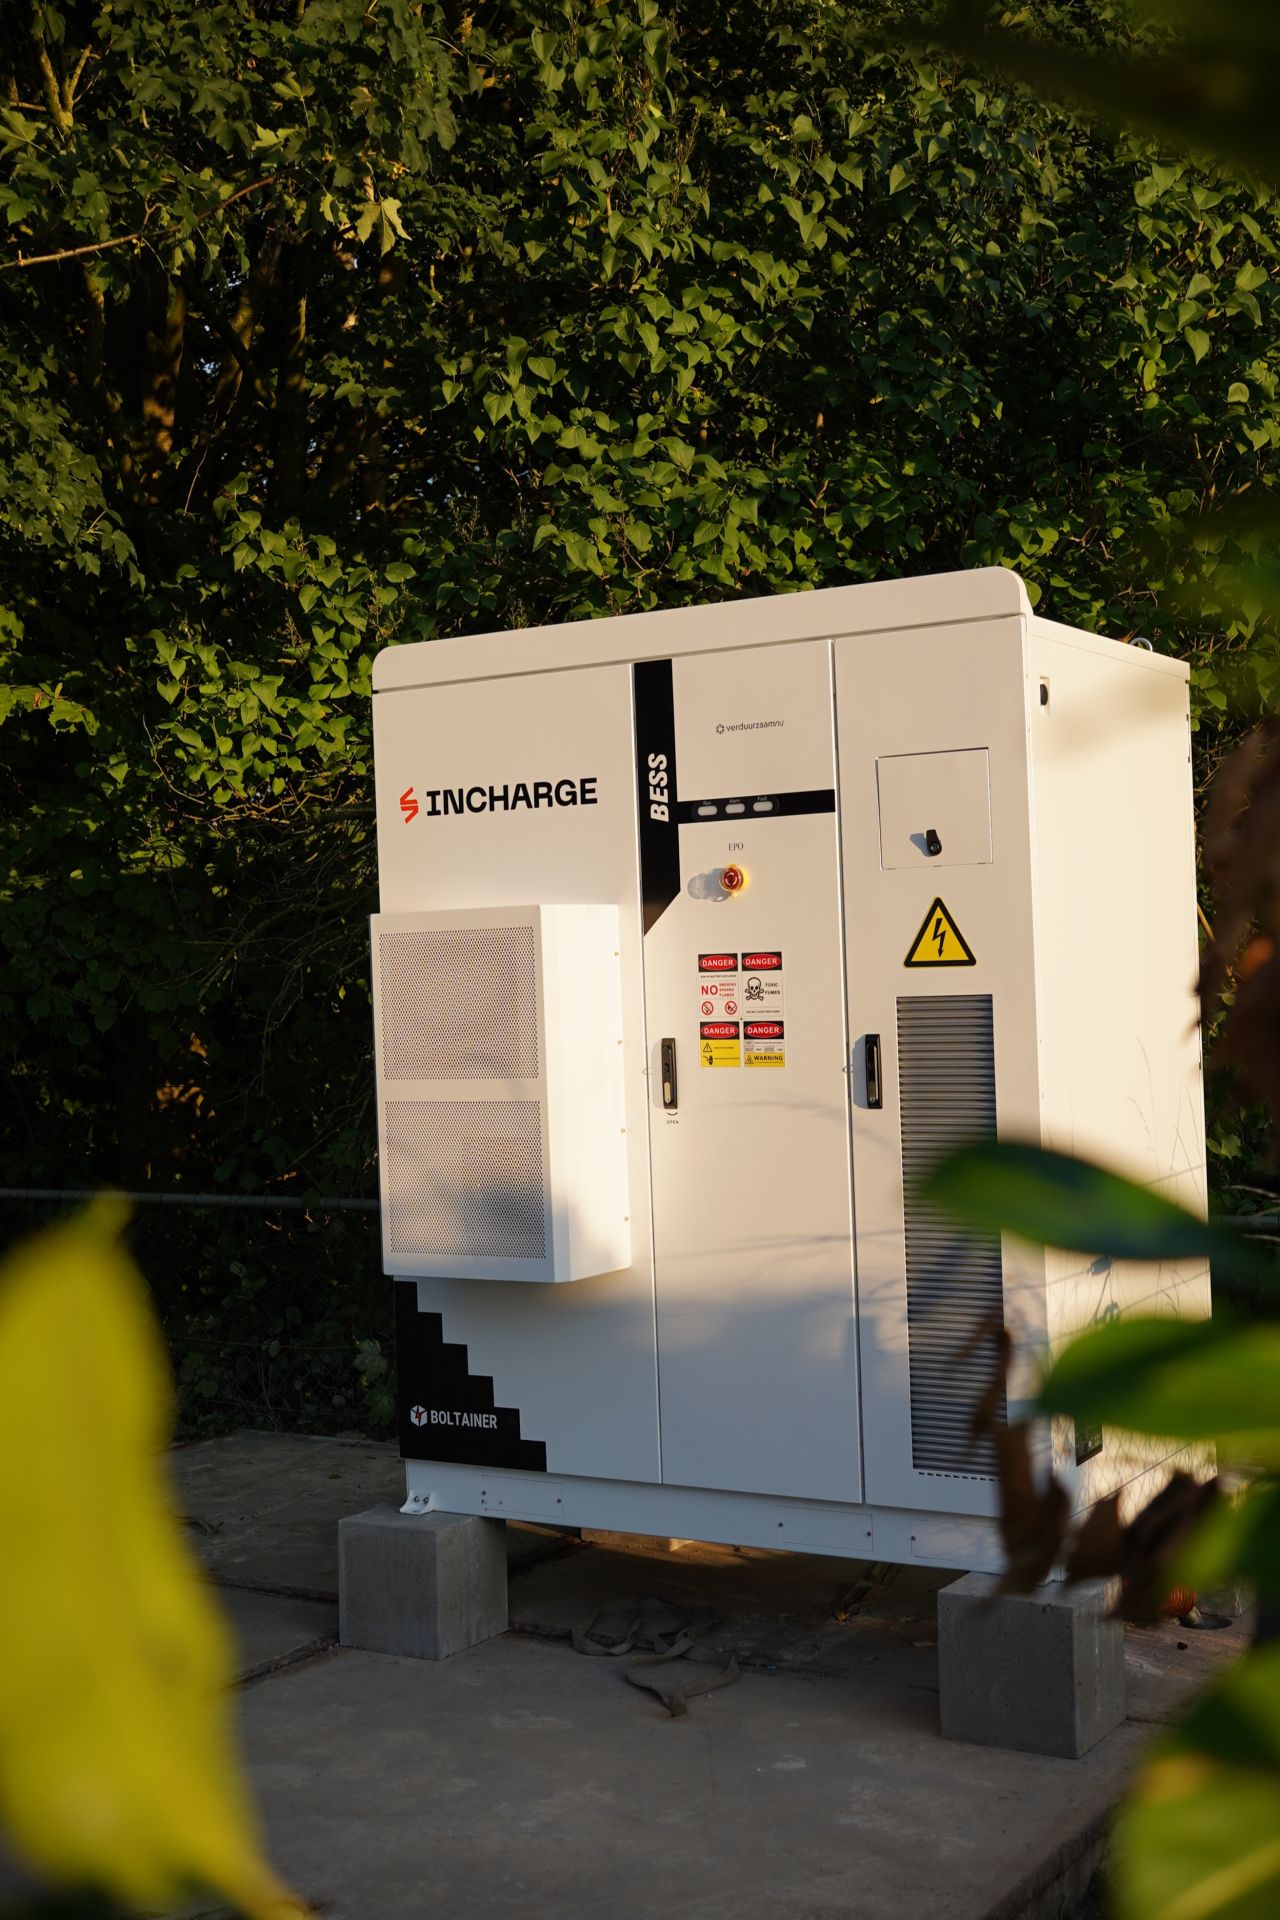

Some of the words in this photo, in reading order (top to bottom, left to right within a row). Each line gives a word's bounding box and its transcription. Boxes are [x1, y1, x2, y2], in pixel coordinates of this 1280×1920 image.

[647, 753, 669, 822] BESS
[426, 777, 598, 816] INCHARGE
[728, 843, 744, 851] EPO
[702, 959, 734, 967] DANGER
[745, 957, 778, 965] DANGER
[701, 984, 719, 996] NO
[703, 1027, 736, 1035] DANGER
[747, 1026, 780, 1034] DANGER
[430, 1410, 498, 1429] BOLTAINER
